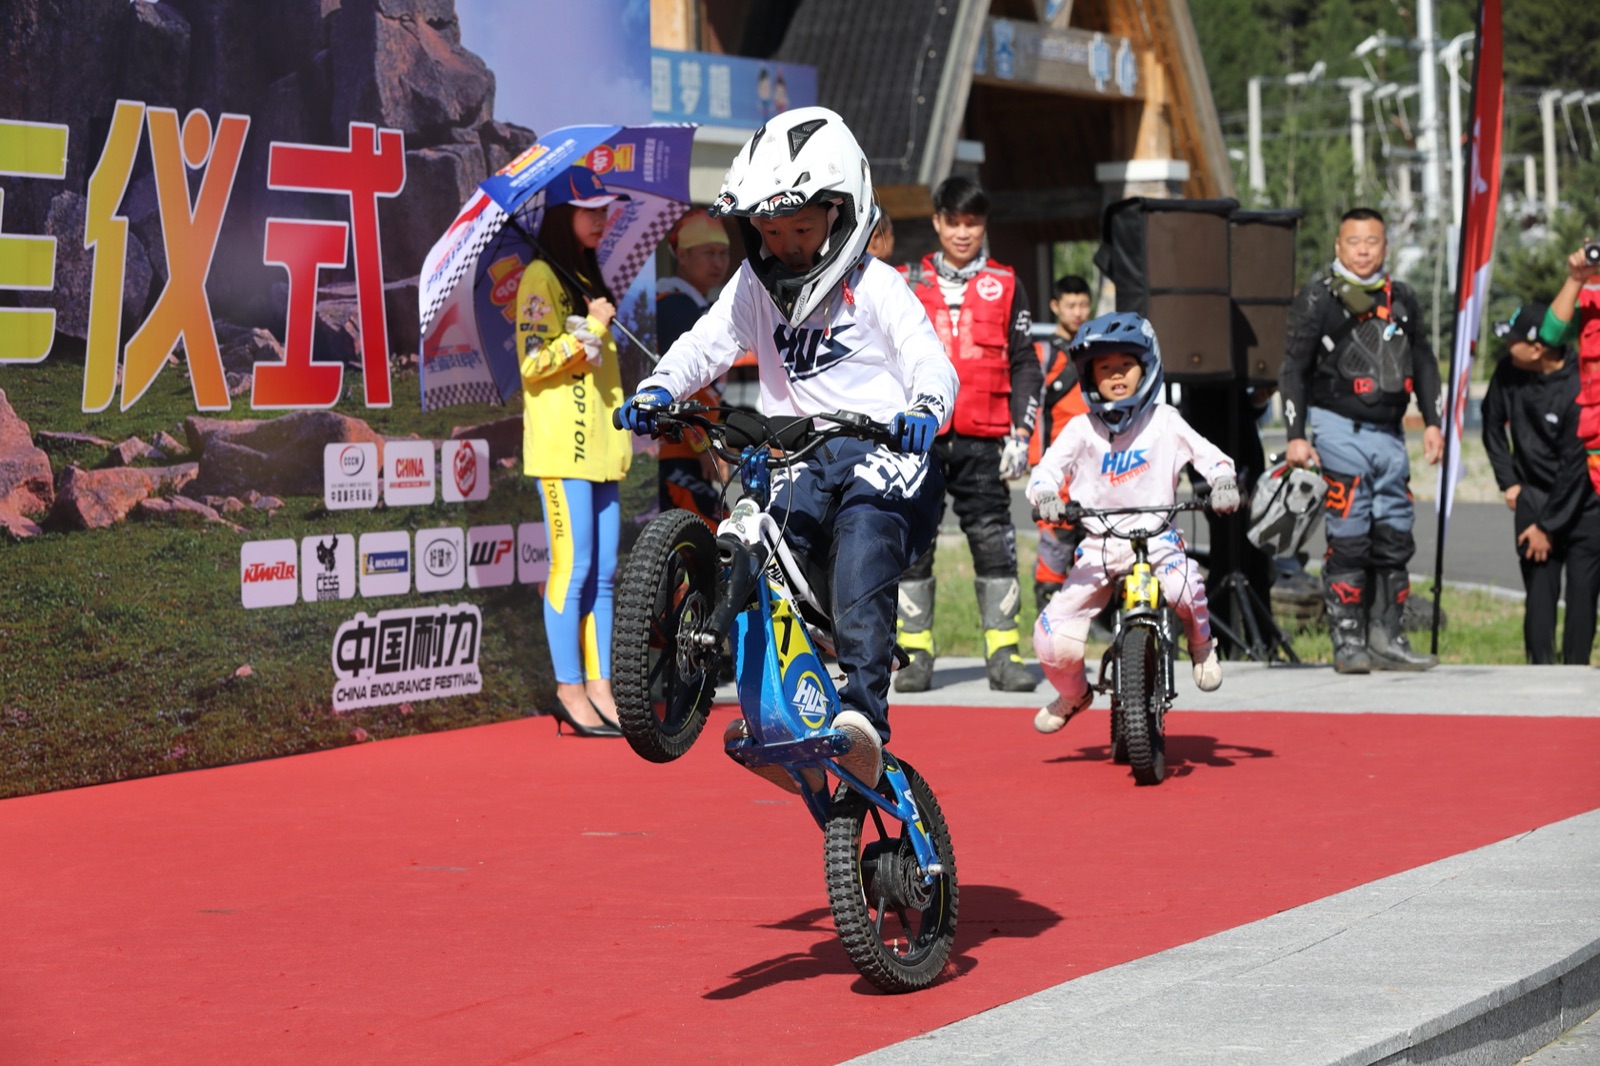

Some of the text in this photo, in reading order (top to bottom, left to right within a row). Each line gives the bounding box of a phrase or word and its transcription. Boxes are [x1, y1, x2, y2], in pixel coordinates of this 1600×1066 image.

[572, 372, 586, 464] TOP 1 OIL
[395, 457, 425, 479] CHINA
[1101, 449, 1149, 476] HUS
[547, 482, 560, 508] TOP
[554, 518, 564, 541] OIL
[375, 557, 406, 569] MICHELIN
[469, 540, 513, 567] WP
[337, 611, 479, 678] 中国耐力
[337, 672, 479, 702] CHINA ENDURANCE FESTIVAL
[792, 679, 830, 714] HUS
